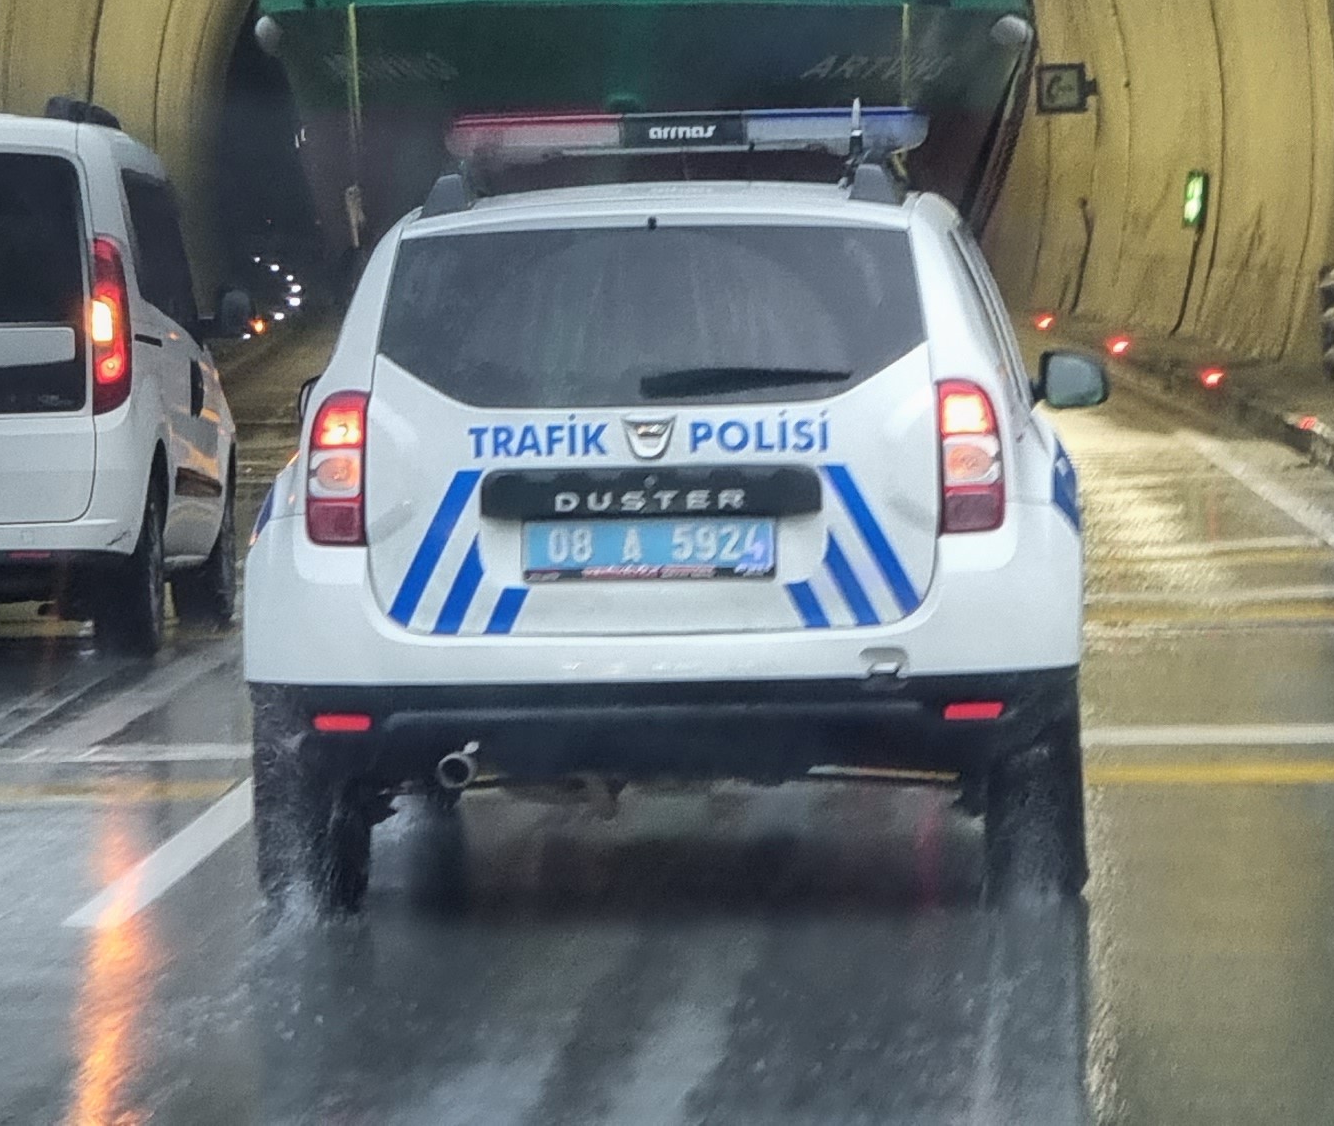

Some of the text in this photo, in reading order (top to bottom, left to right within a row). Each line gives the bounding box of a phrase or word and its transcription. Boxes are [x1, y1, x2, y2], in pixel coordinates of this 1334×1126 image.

[468, 410, 830, 459] TRAFİK POLİSİ
[554, 488, 747, 512] DUSTER
[548, 524, 766, 563] 08 A 5924
